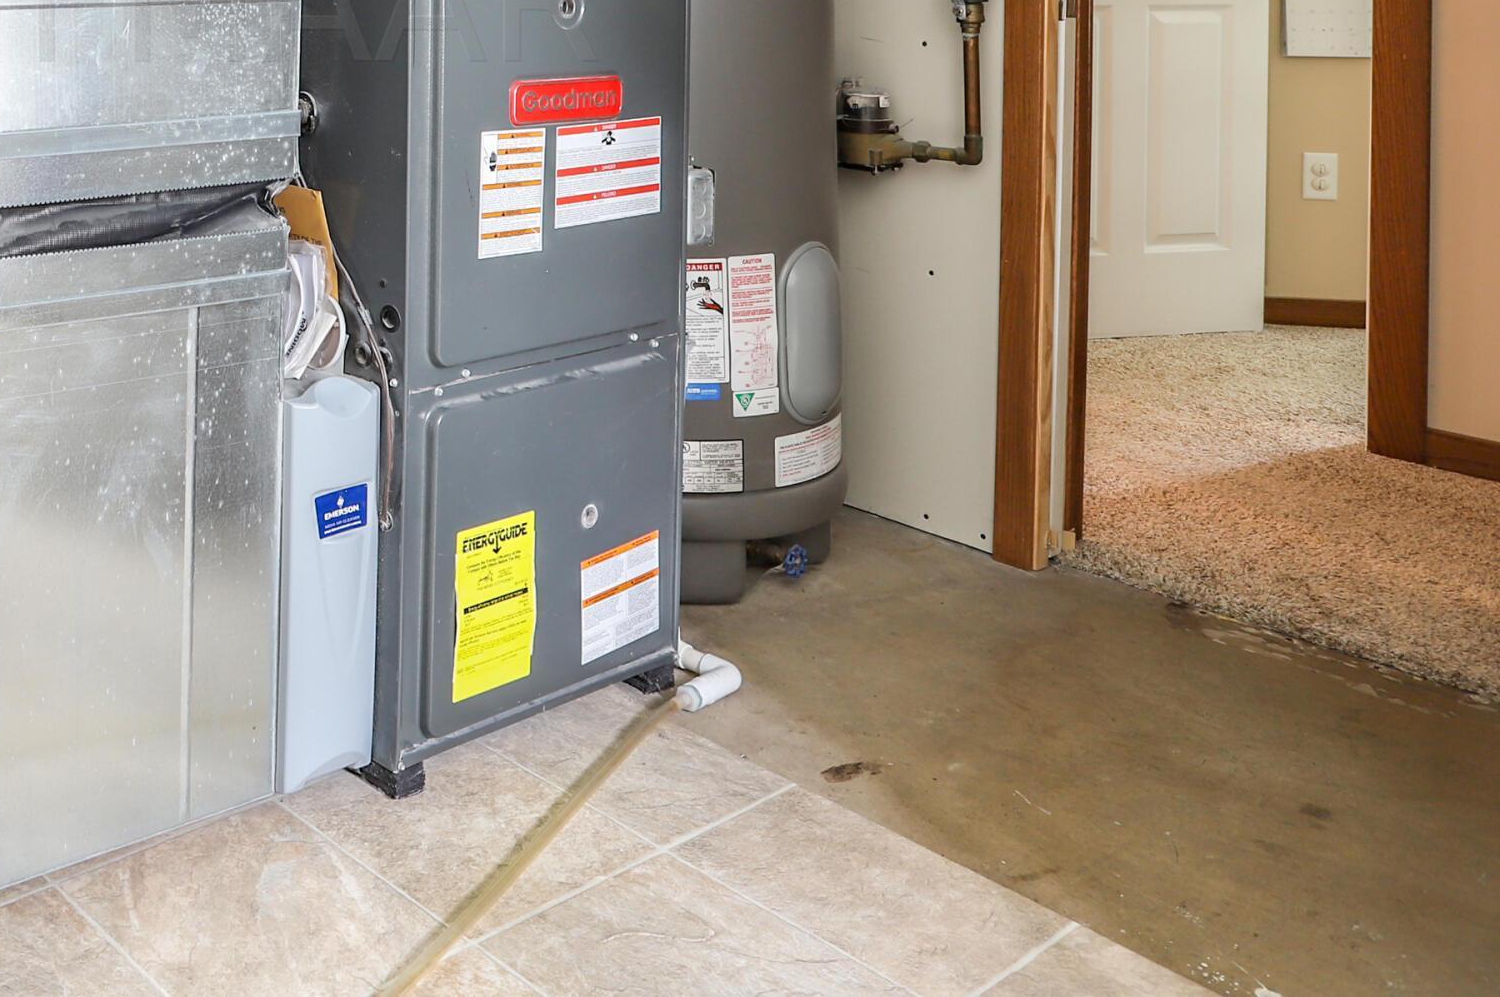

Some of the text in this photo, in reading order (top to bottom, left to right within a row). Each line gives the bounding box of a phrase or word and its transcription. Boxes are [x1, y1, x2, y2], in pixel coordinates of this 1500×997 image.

[521, 88, 617, 112] Goodman
[686, 263, 720, 271] DANGER
[324, 504, 360, 521] EMERSON
[462, 522, 528, 554] ENERGYGUIDE
